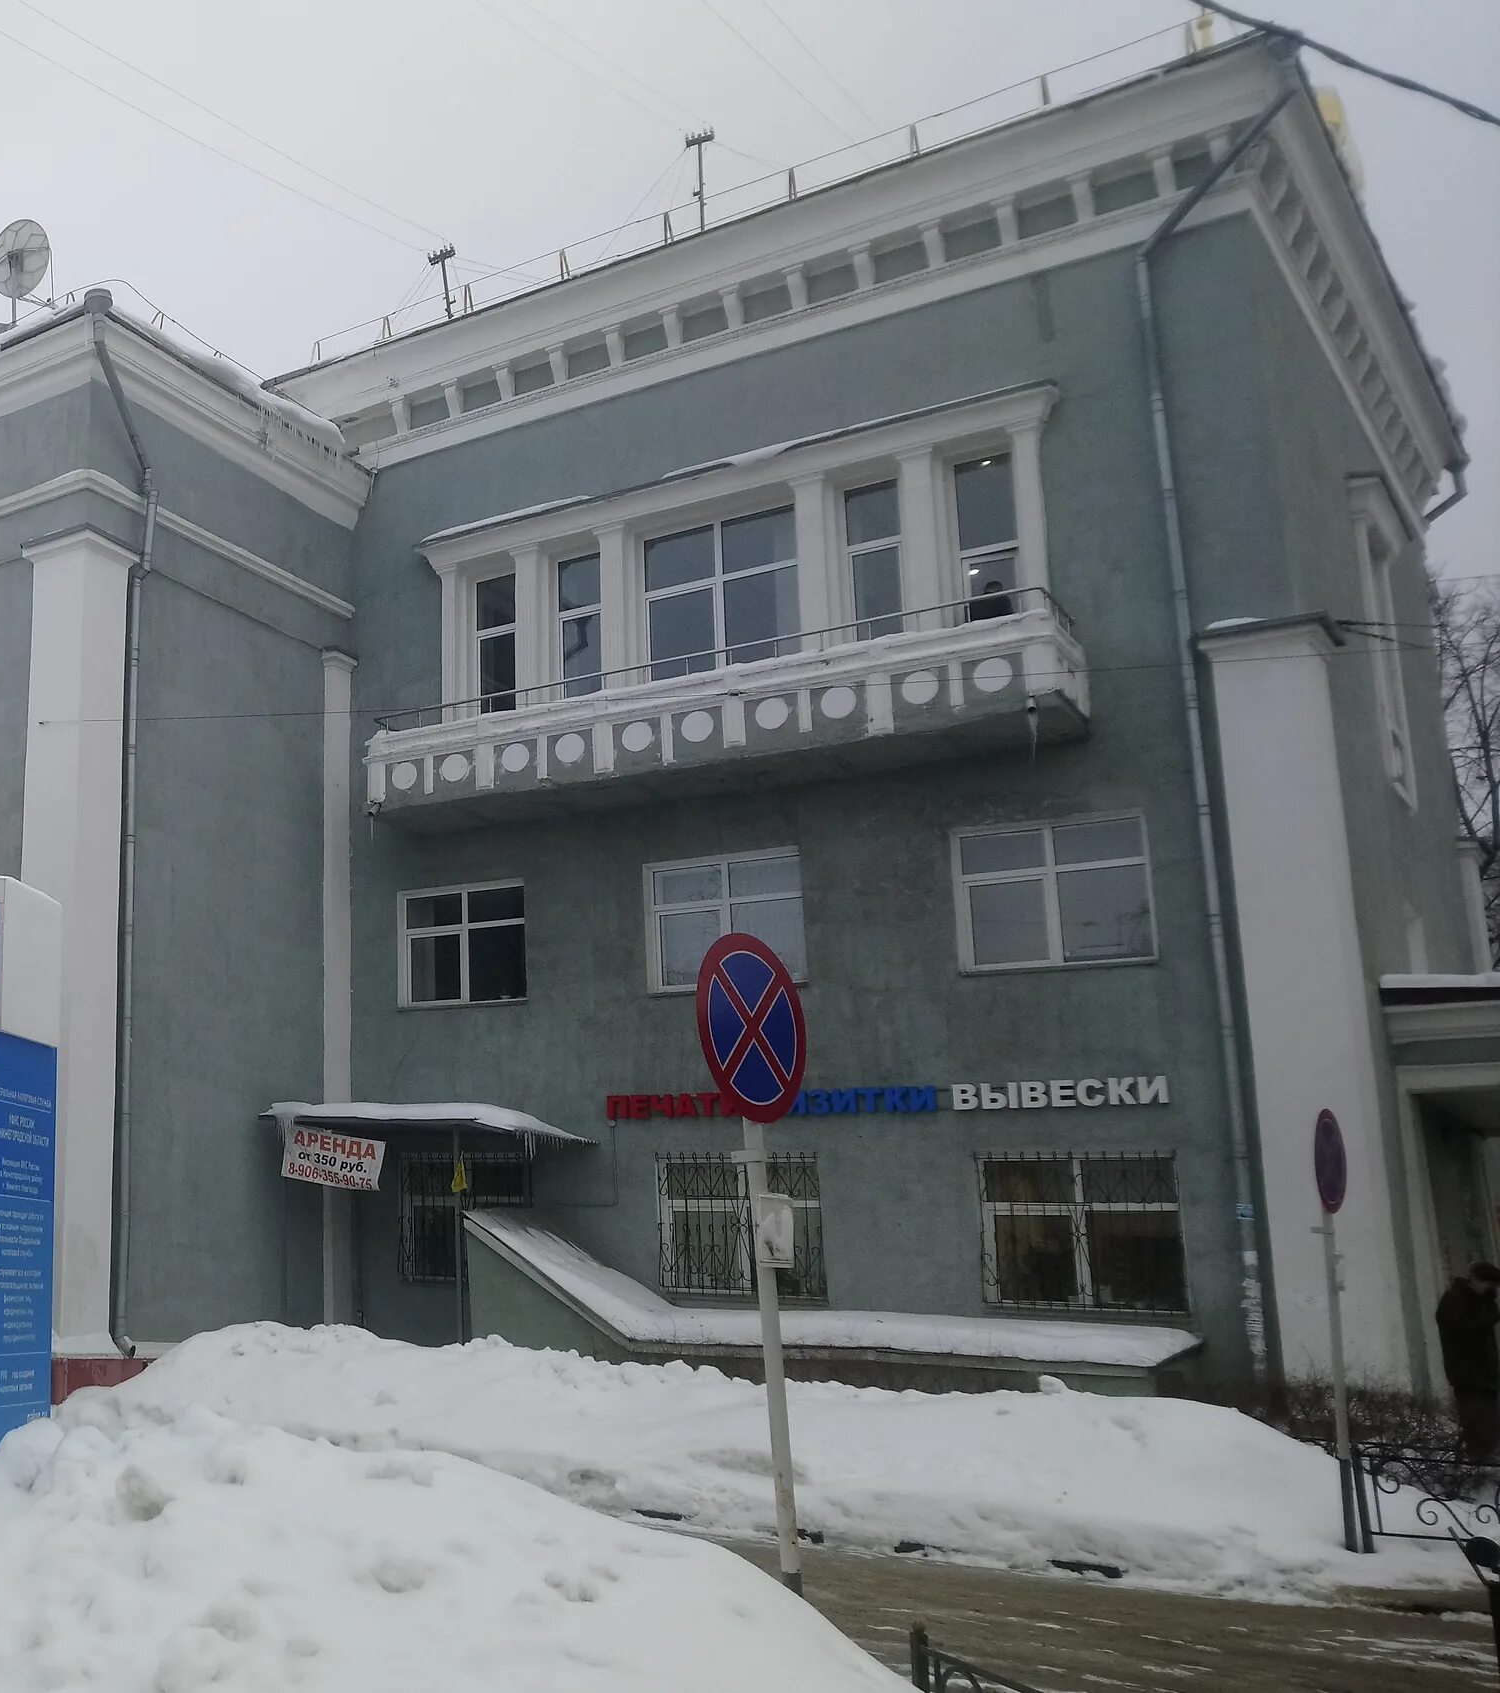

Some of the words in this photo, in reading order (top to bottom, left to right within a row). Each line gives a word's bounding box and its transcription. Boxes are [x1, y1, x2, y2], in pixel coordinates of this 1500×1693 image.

[788, 1085, 938, 1116] ИЗИТКИ
[951, 1075, 1170, 1111] ВЫВЕСКИ
[293, 1130, 376, 1160] АРЕНДА
[288, 1162, 373, 1190] 8-906-355-90-75
[298, 1151, 311, 1161] от
[314, 1153, 337, 1167] 350
[340, 1160, 367, 1174] руб.
